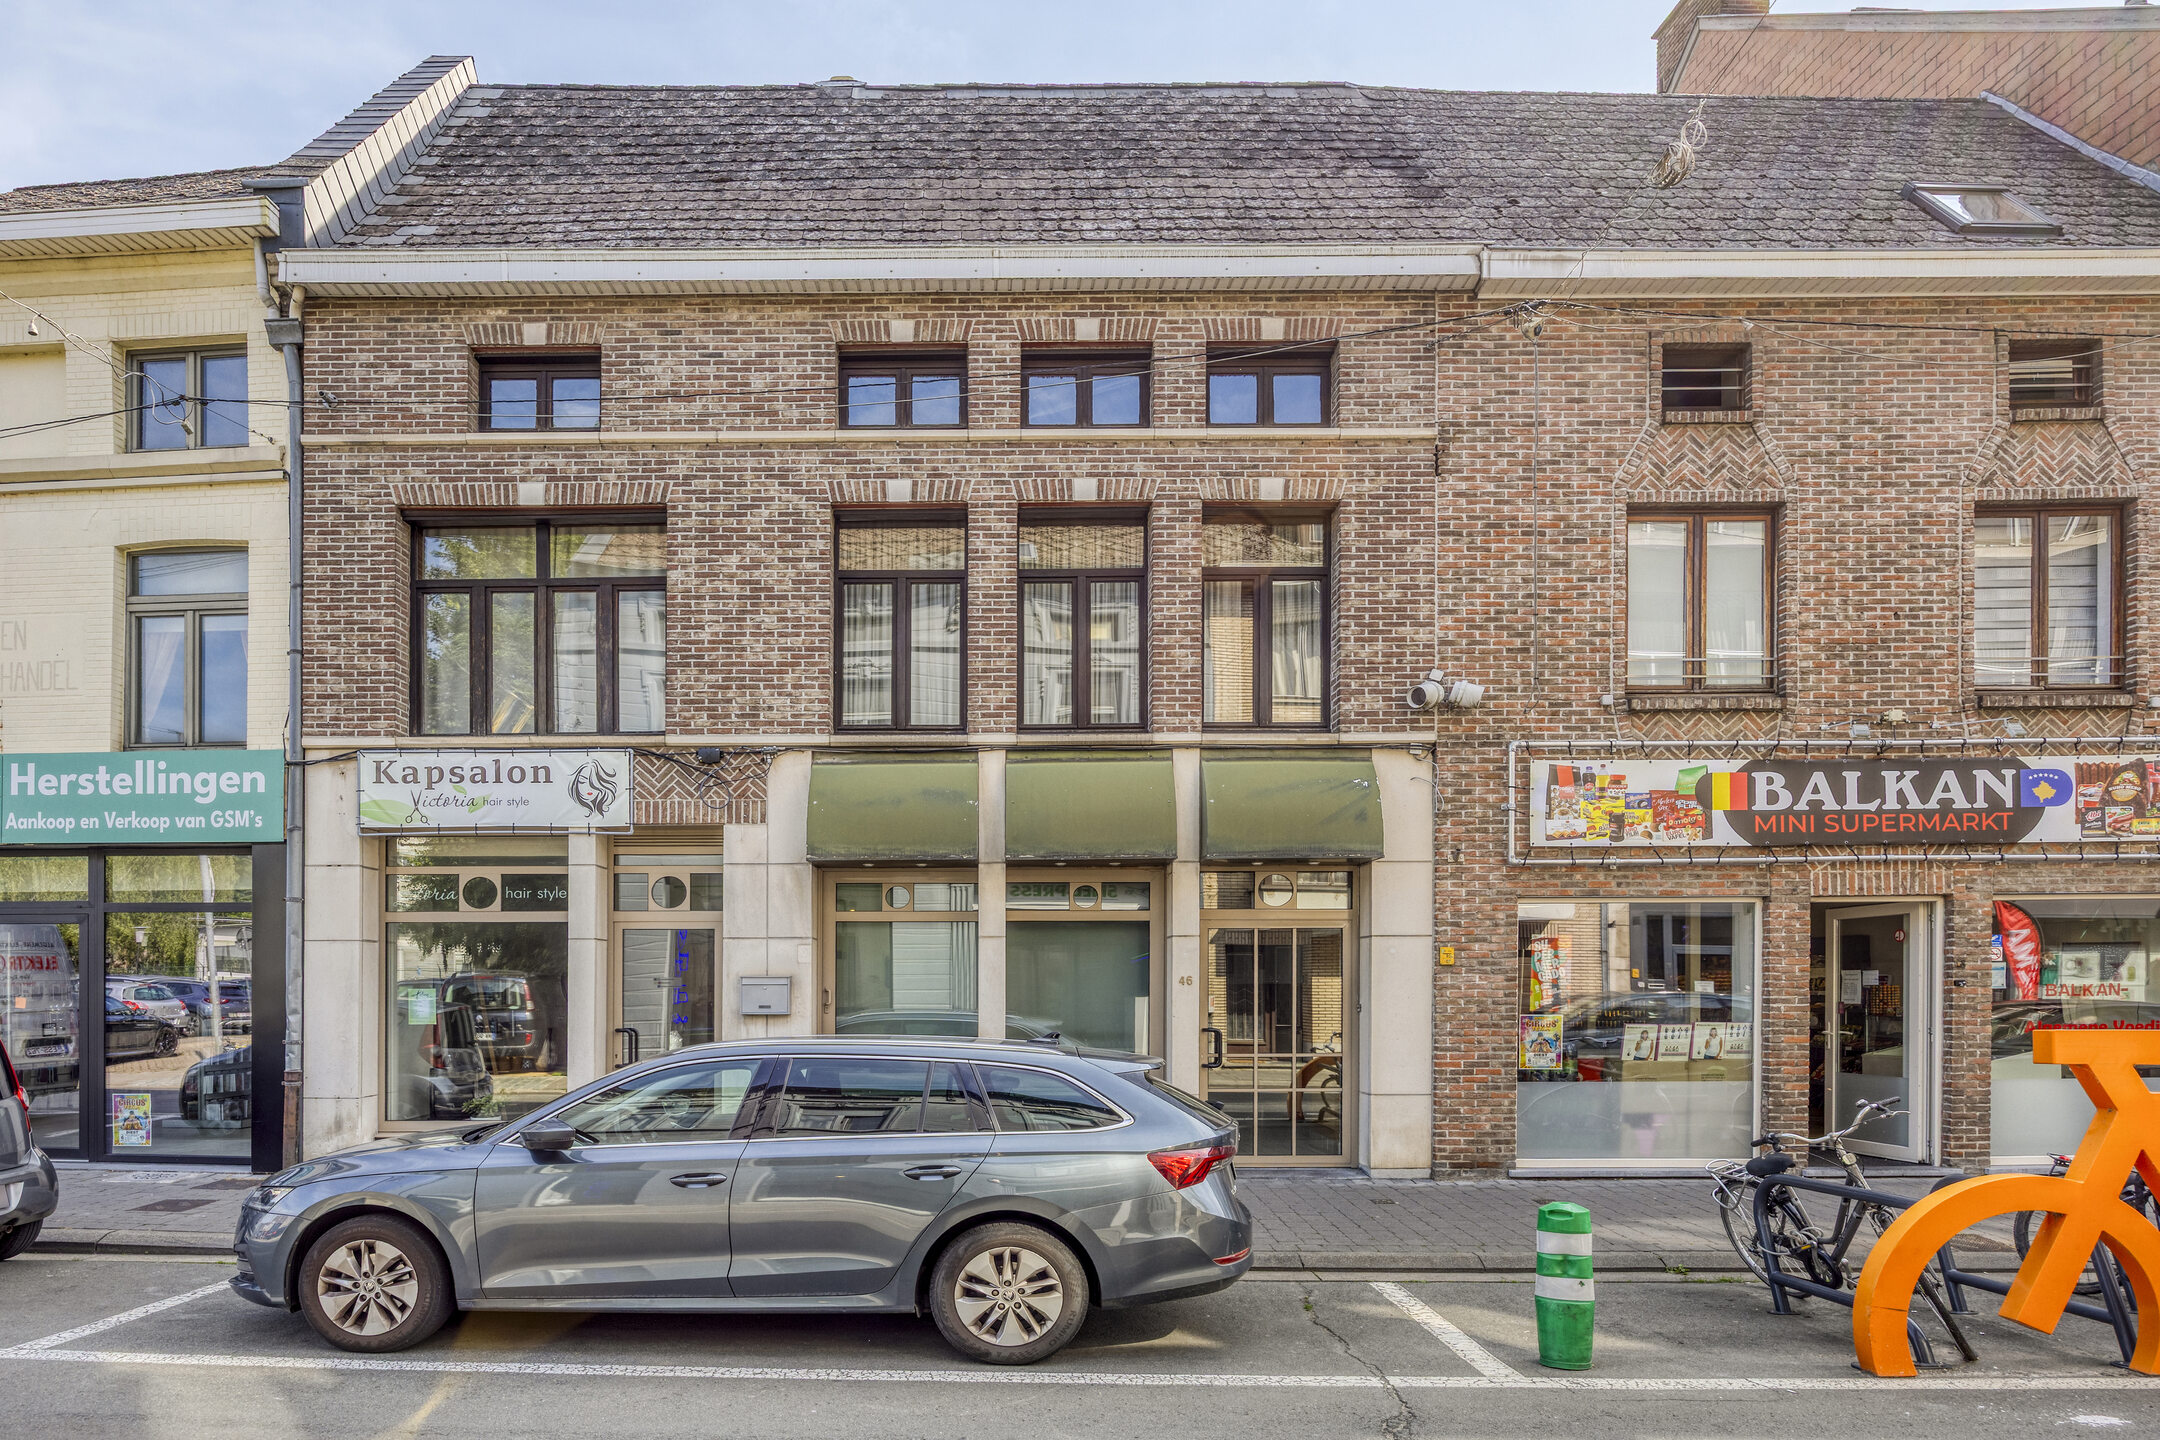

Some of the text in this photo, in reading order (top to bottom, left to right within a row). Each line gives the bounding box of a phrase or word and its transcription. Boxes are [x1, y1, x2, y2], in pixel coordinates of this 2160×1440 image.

[0, 660, 79, 692] HANDEL
[10, 760, 266, 804] Herstellingen
[372, 759, 553, 790] Kapsalon
[1751, 769, 2017, 811] BALKAN
[483, 797, 504, 806] hair
[506, 796, 530, 808] style
[5, 810, 263, 833] Aankoop en Verkoop van GSM's
[1754, 812, 2014, 833] MINI SUPERMARKT
[505, 886, 532, 898] hair
[537, 886, 567, 901] style
[1179, 976, 1193, 986] 46
